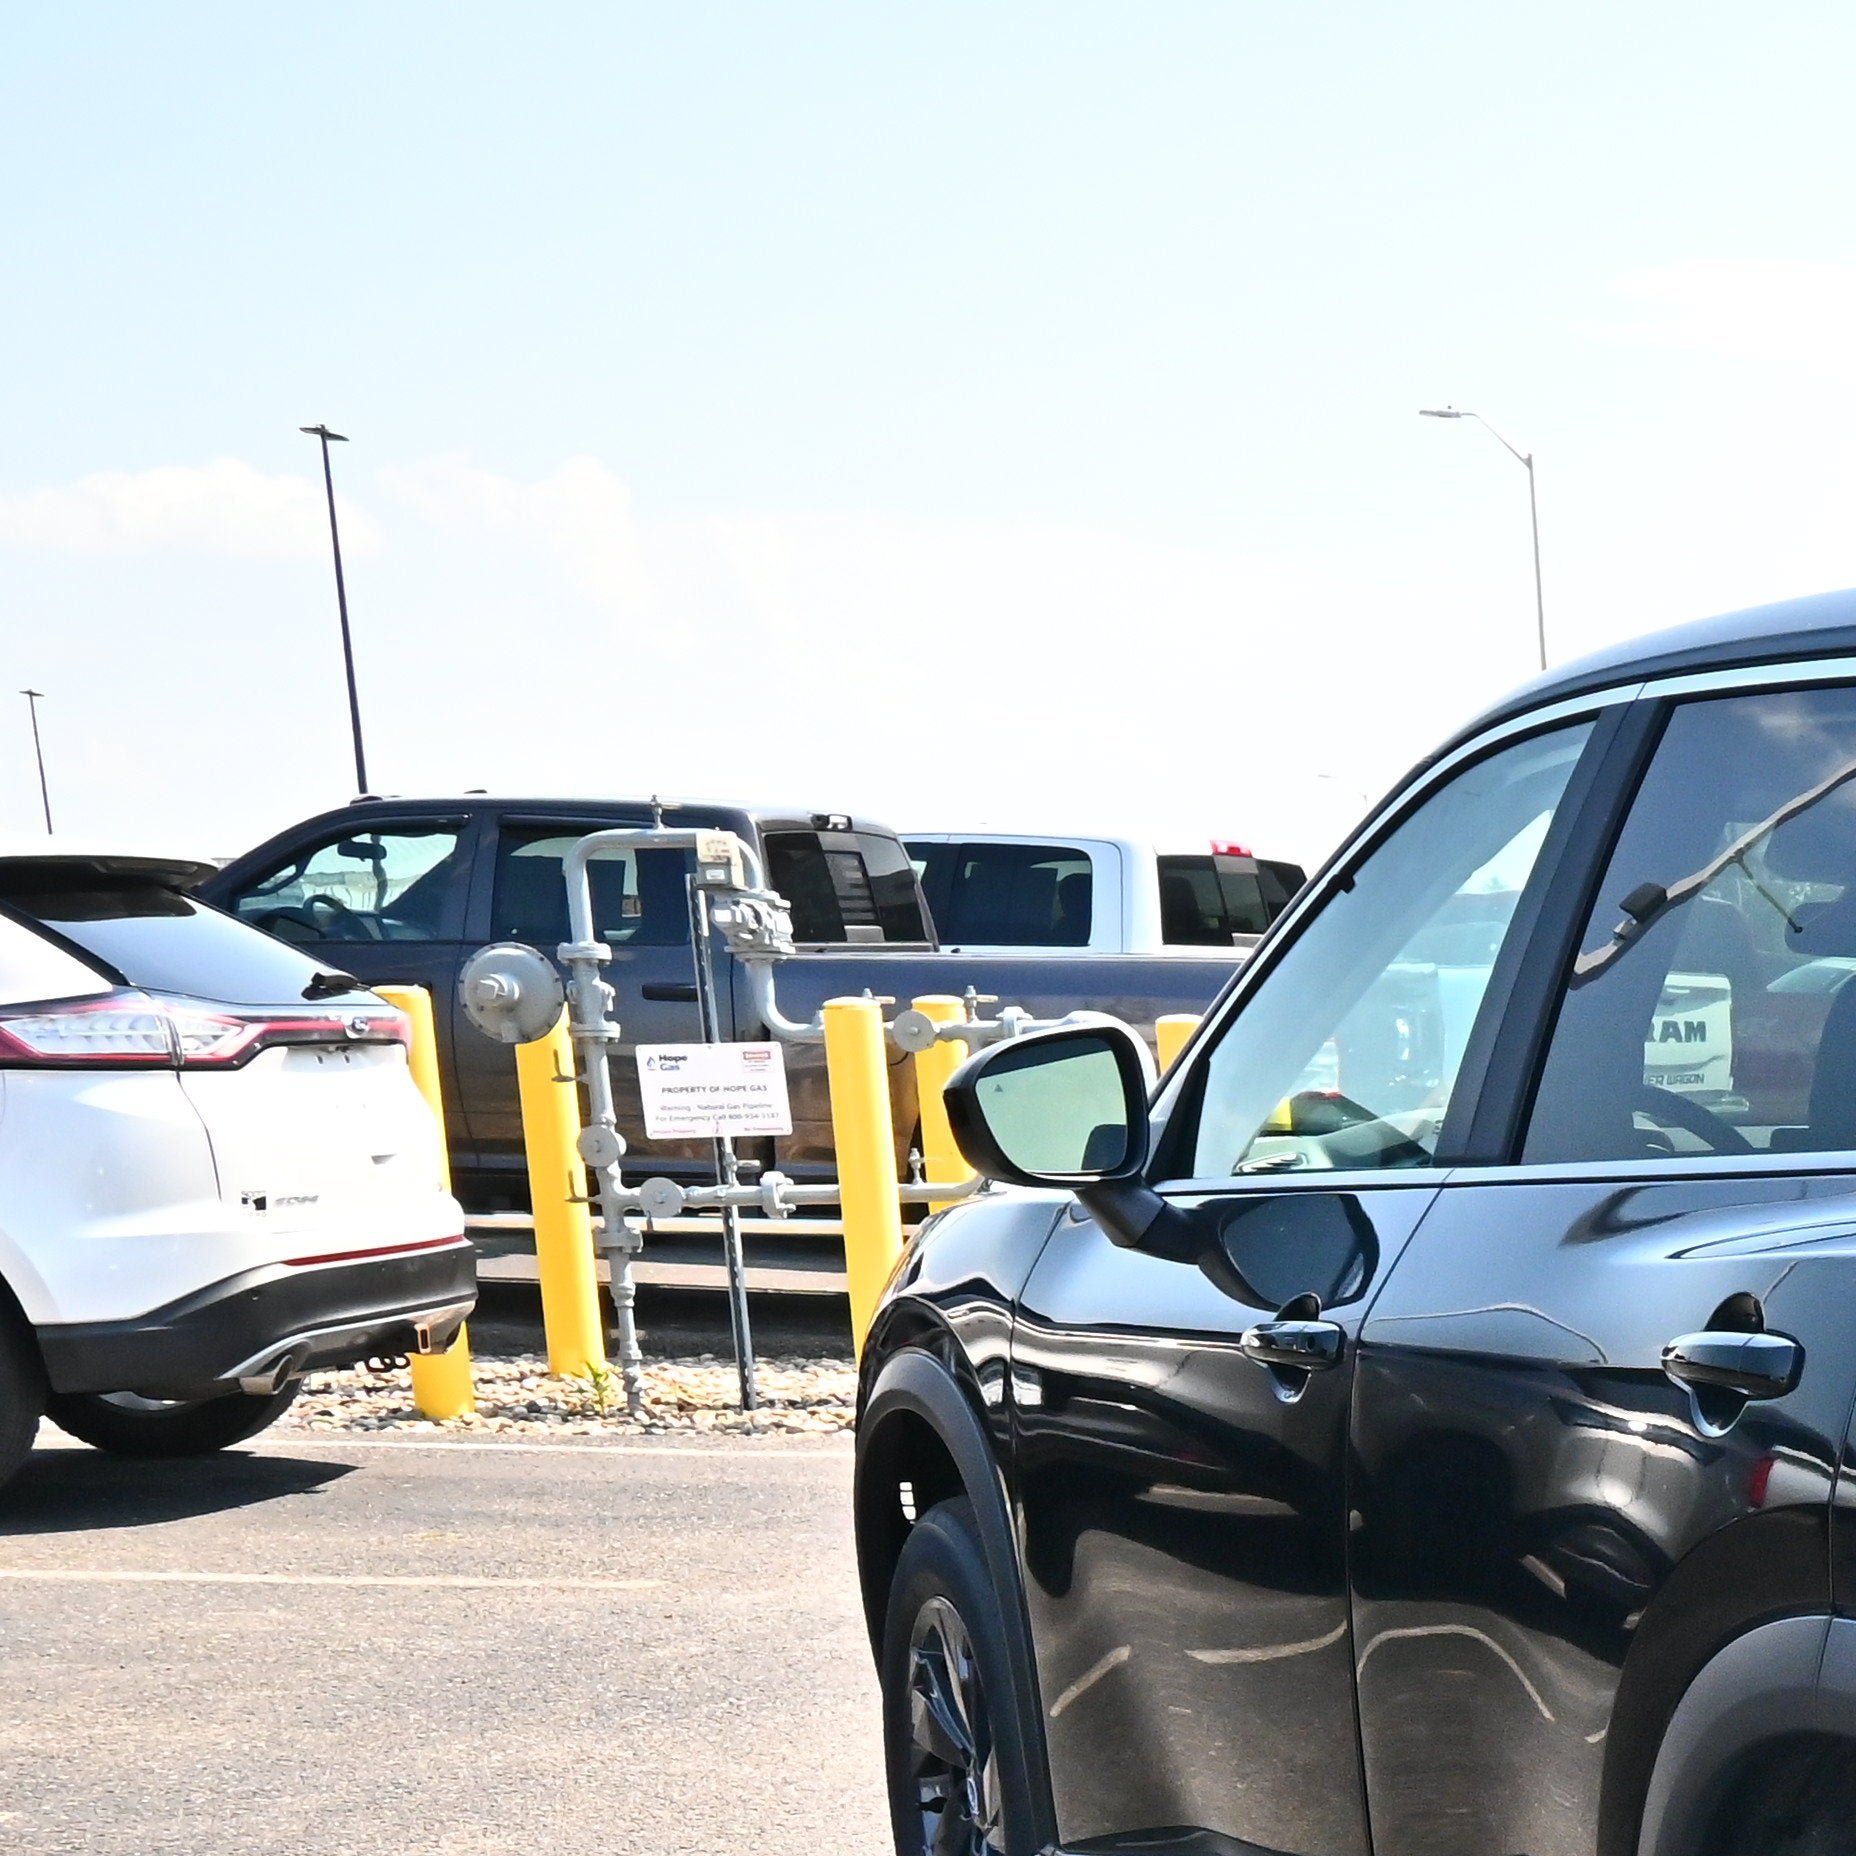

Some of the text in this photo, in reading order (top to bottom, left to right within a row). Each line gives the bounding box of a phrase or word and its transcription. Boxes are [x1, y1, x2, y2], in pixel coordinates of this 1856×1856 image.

[1647, 1020, 1707, 1043] AM
[658, 1054, 688, 1063] Hope
[660, 1063, 681, 1071] Gas
[661, 1086, 707, 1094] PROPERTY
[750, 1084, 768, 1092] GAS
